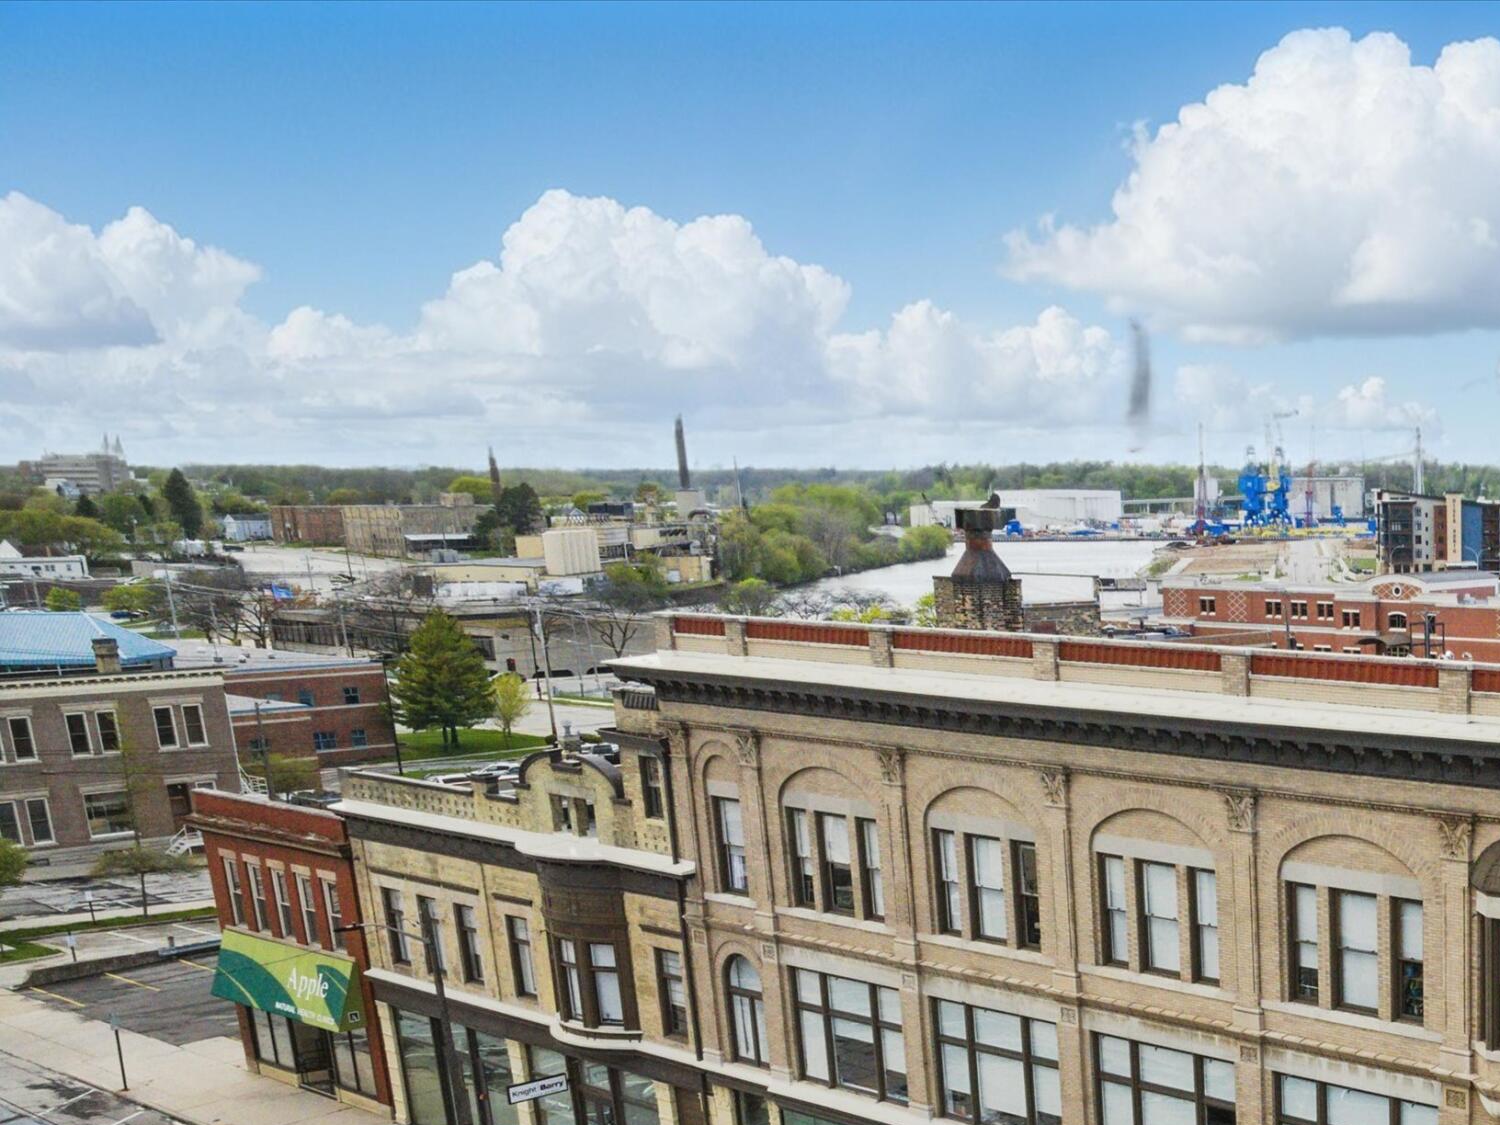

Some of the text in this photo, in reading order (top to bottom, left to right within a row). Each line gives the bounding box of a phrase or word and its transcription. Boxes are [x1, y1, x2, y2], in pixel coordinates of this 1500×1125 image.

[287, 967, 329, 1000] Apple
[511, 1087, 538, 1099] Knight
[540, 1080, 564, 1090] Barry
